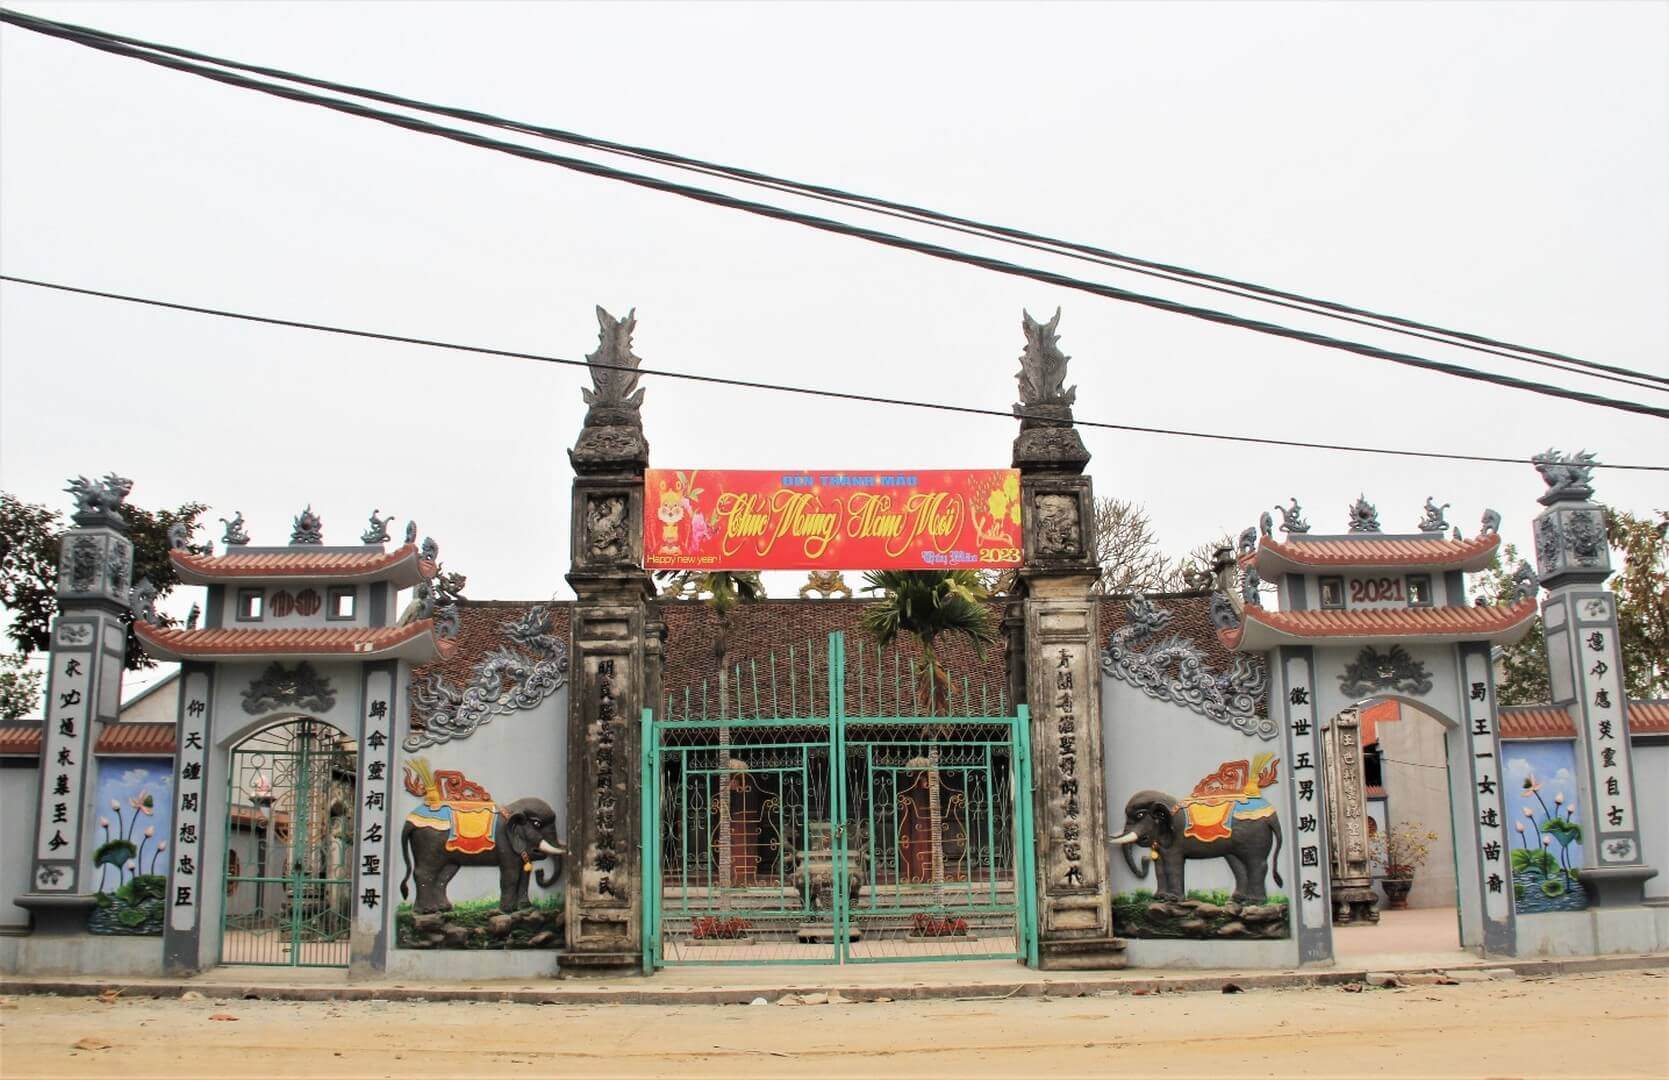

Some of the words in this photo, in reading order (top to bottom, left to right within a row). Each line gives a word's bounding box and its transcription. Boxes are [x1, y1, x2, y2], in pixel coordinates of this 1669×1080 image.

[716, 491, 770, 556] Chúc
[755, 488, 844, 559] Mừng
[847, 491, 908, 539] Năm
[885, 491, 965, 557] Mới
[646, 553, 674, 566] Happy
[677, 555, 695, 564] new
[979, 547, 1022, 563] 2023
[1350, 577, 1406, 604] 2021
